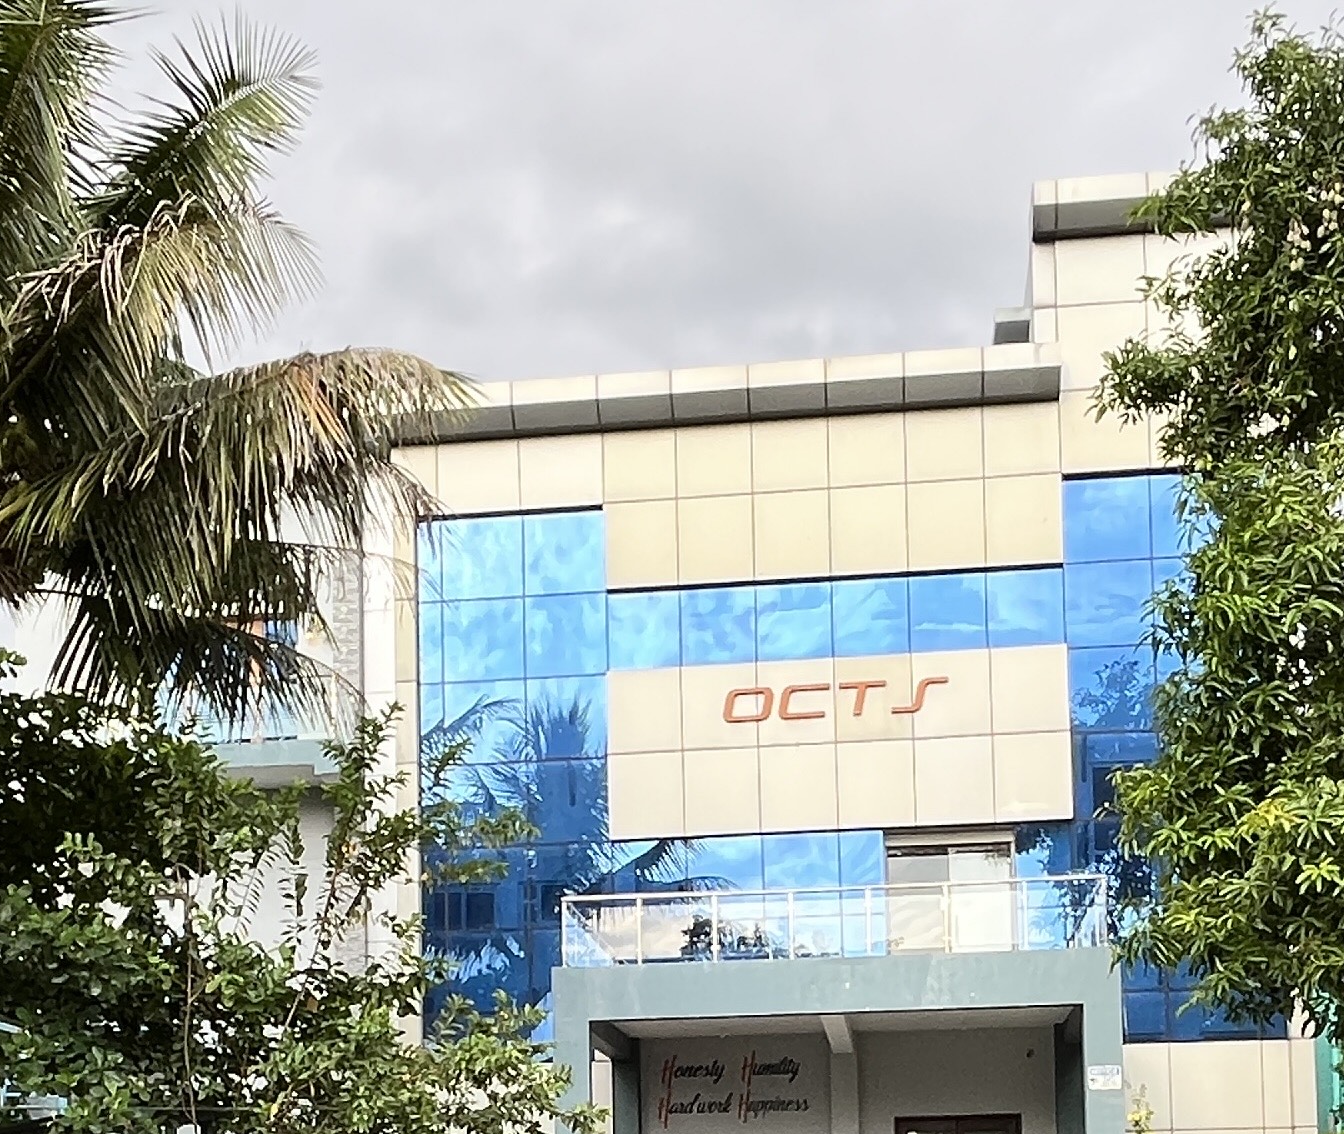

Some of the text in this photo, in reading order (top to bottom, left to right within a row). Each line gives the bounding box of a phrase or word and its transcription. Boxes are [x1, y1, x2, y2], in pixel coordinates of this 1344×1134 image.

[723, 676, 949, 723] OCTS
[661, 1050, 801, 1089] Honesty Humility
[738, 1089, 809, 1123] Happiness
